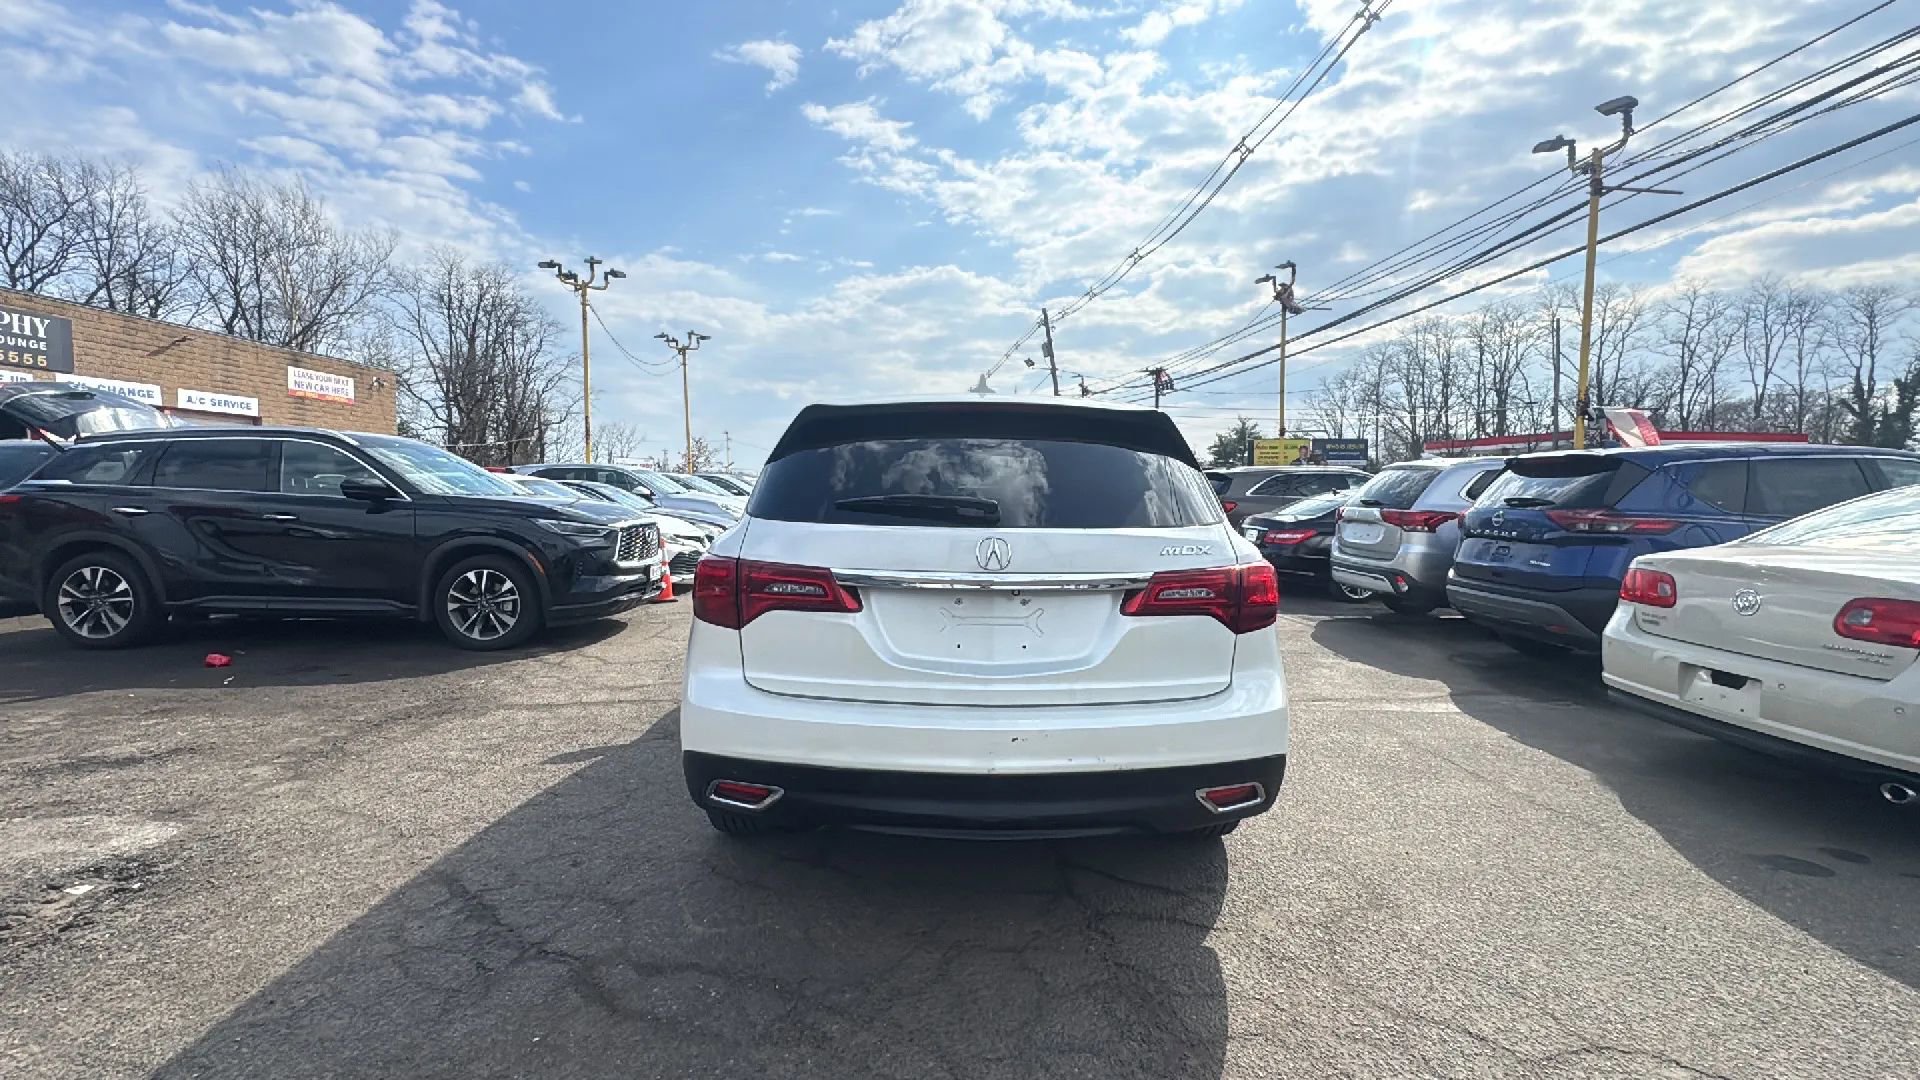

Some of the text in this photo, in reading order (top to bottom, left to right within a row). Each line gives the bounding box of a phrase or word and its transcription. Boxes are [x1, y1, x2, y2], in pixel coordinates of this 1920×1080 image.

[294, 379, 313, 390] NEW
[314, 383, 330, 393] CAR
[331, 386, 349, 397] HERE
[186, 395, 252, 411] A/C SERVICE
[1160, 545, 1214, 556] MDX
